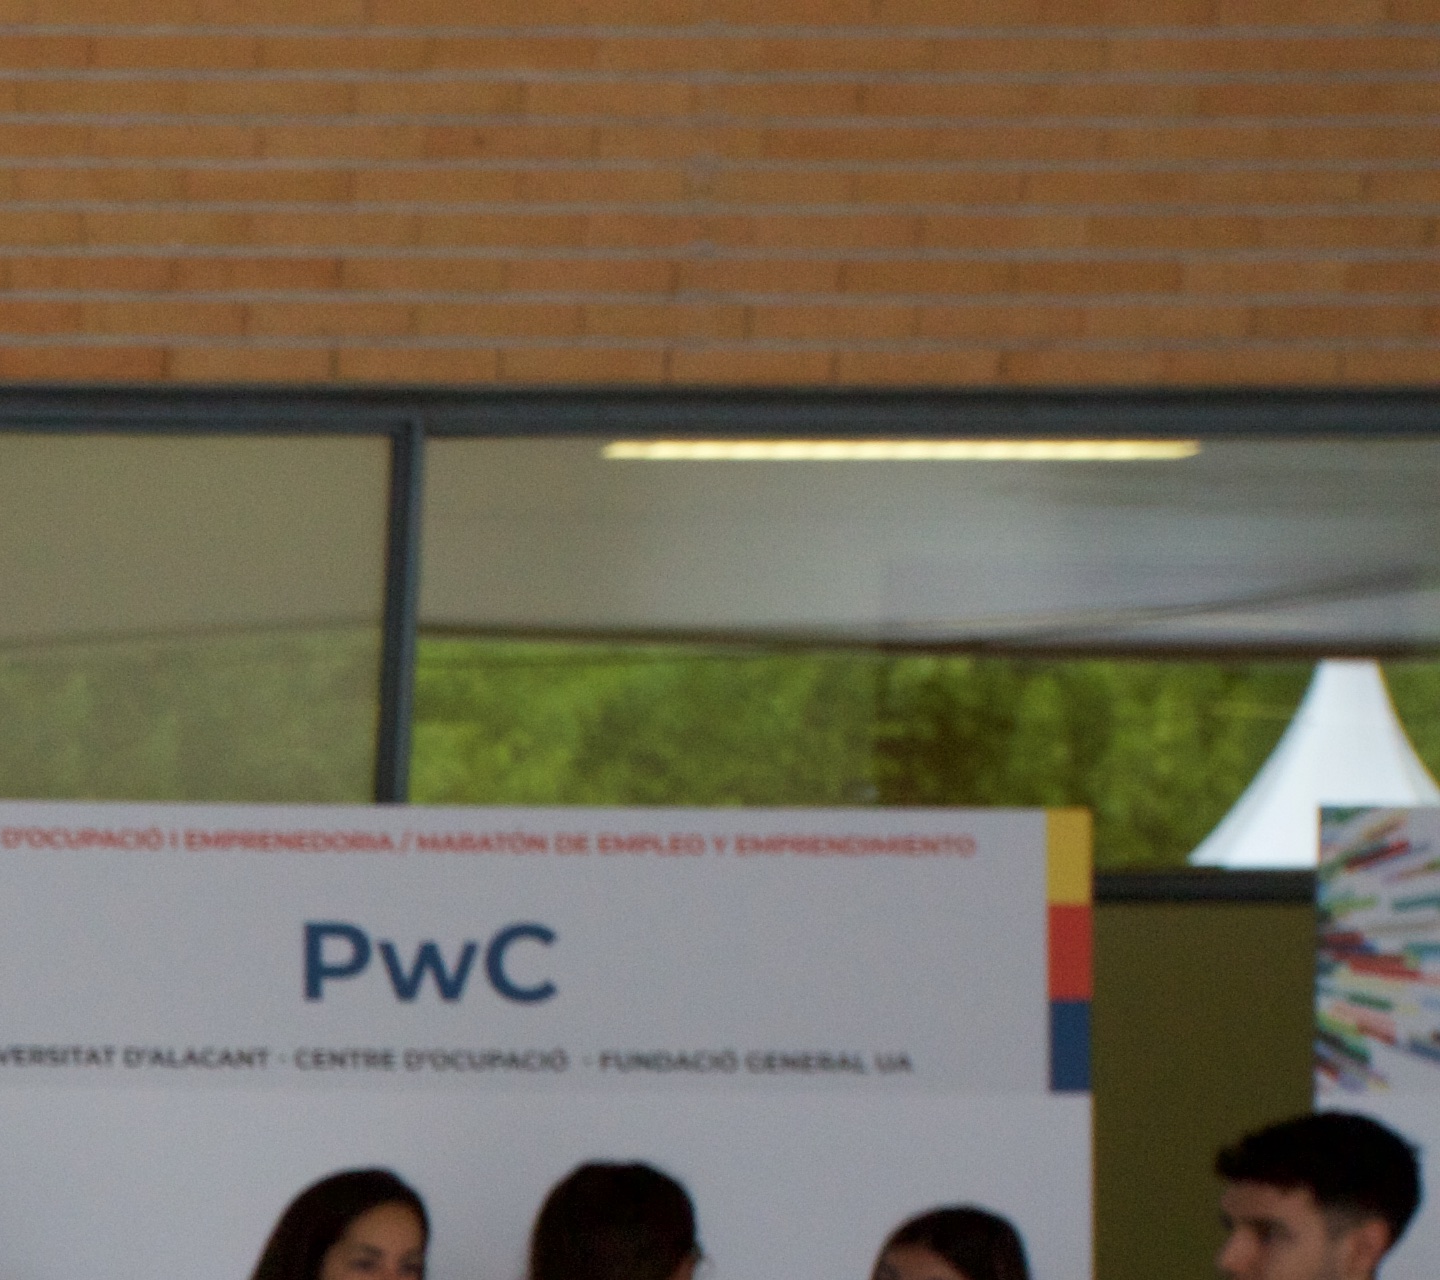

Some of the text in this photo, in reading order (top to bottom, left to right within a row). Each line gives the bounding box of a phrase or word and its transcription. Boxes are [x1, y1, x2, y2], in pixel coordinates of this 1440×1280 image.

[1, 826, 164, 850] D'OCUPACIÓ
[184, 829, 395, 853] EMPRENEDORIA
[417, 831, 547, 855] MARATÓN
[554, 833, 589, 855] DE
[598, 833, 706, 856] EMPLEO
[713, 835, 727, 855] Y
[735, 834, 976, 858] EMPRENDIMIENTO
[303, 922, 558, 1003] PwC
[123, 1045, 269, 1071] D'ALACANT
[293, 1048, 397, 1072] CENTRE
[403, 1047, 570, 1074] D'OCUPACIÓ
[599, 1048, 738, 1074] FUNDACIÓ
[744, 1052, 866, 1075] GENERAL
[874, 1052, 913, 1075] UA
